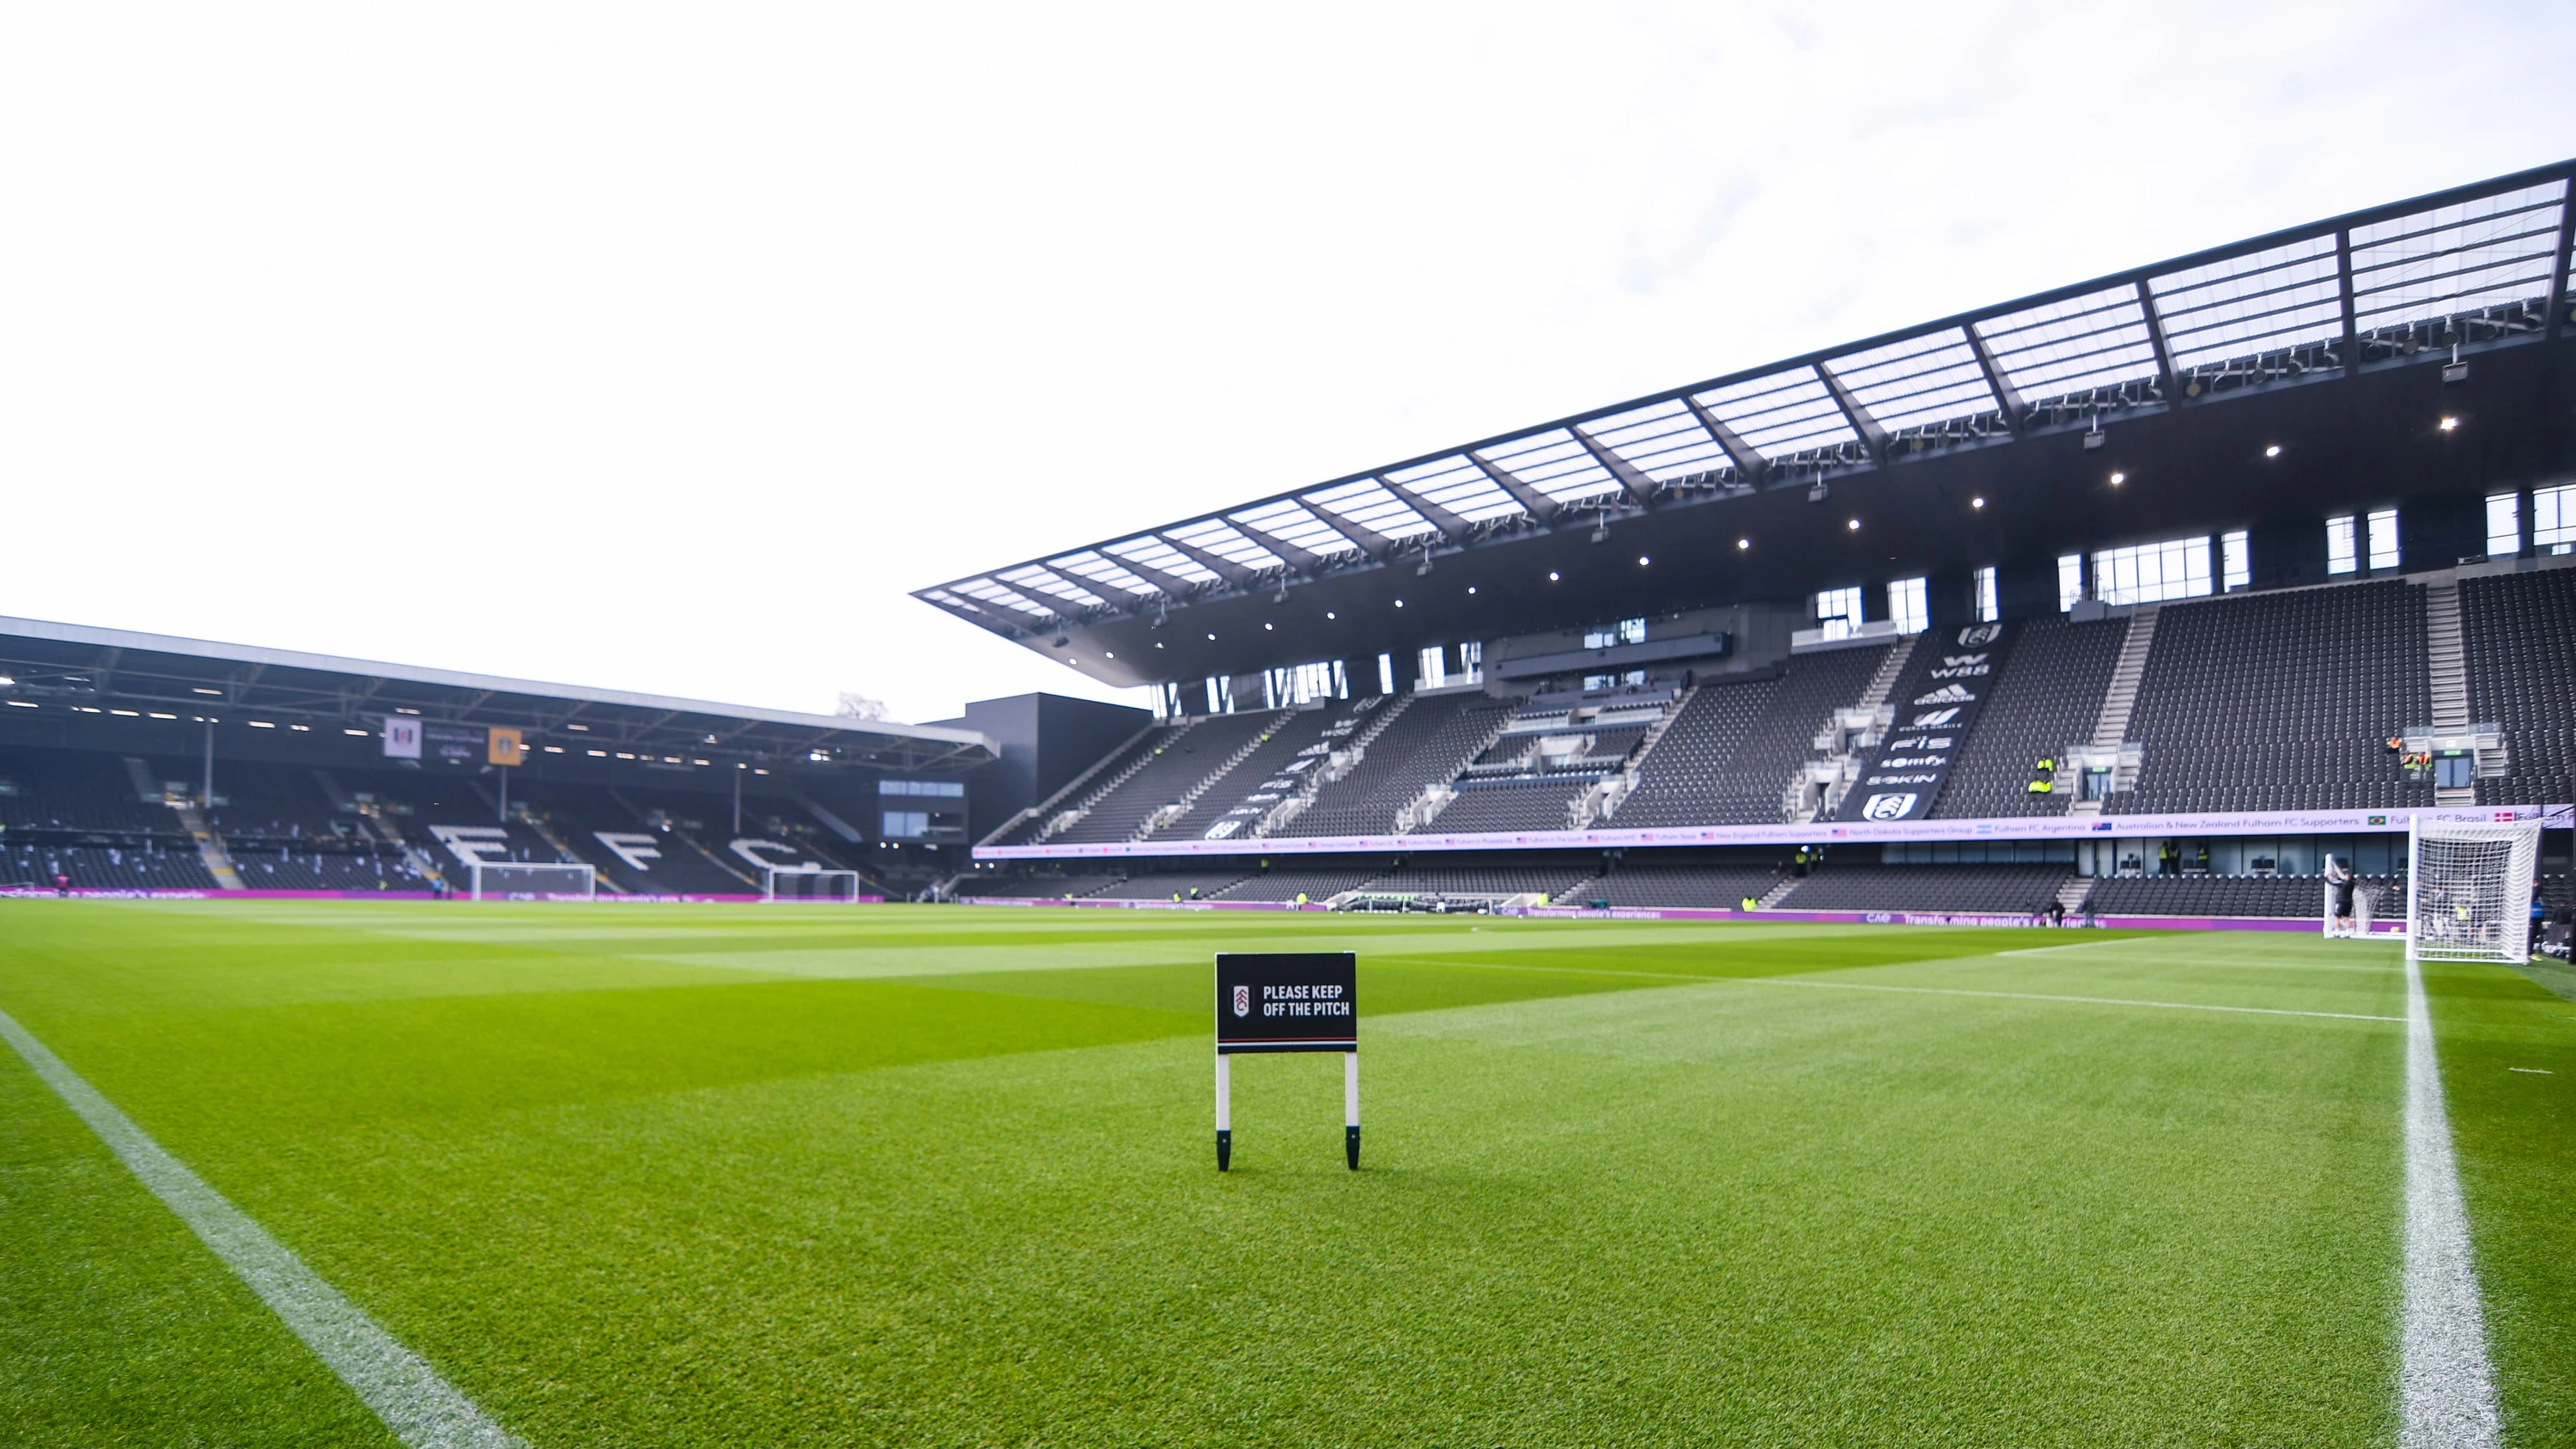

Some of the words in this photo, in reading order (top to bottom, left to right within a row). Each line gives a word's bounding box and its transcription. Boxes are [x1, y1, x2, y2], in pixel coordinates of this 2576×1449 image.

[1930, 664, 1990, 679] W88
[1913, 693, 1975, 705] adidas
[2454, 813, 2487, 822] Brasil
[1995, 824, 2026, 832] Fulham
[2028, 823, 2040, 831] FC
[2042, 822, 2086, 832] Argentina
[2116, 821, 2164, 831] Australian
[2199, 819, 2240, 829] Zealand
[2243, 819, 2281, 827] Fulham
[2284, 818, 2298, 826] FC
[2300, 817, 2360, 828] Supporters
[1789, 830, 1826, 839] Supporters
[1903, 826, 1945, 836] Supporters
[1947, 825, 1972, 835] Group
[592, 831, 661, 870] F
[1528, 908, 1577, 918] Transforming
[1612, 910, 1662, 919] experiences
[1263, 985, 1309, 1000] PLEASE
[1311, 984, 1343, 999] KEEP
[1263, 1002, 1286, 1016] OFF
[1288, 1002, 1311, 1016] THE
[1314, 1002, 1350, 1015] PITCH
